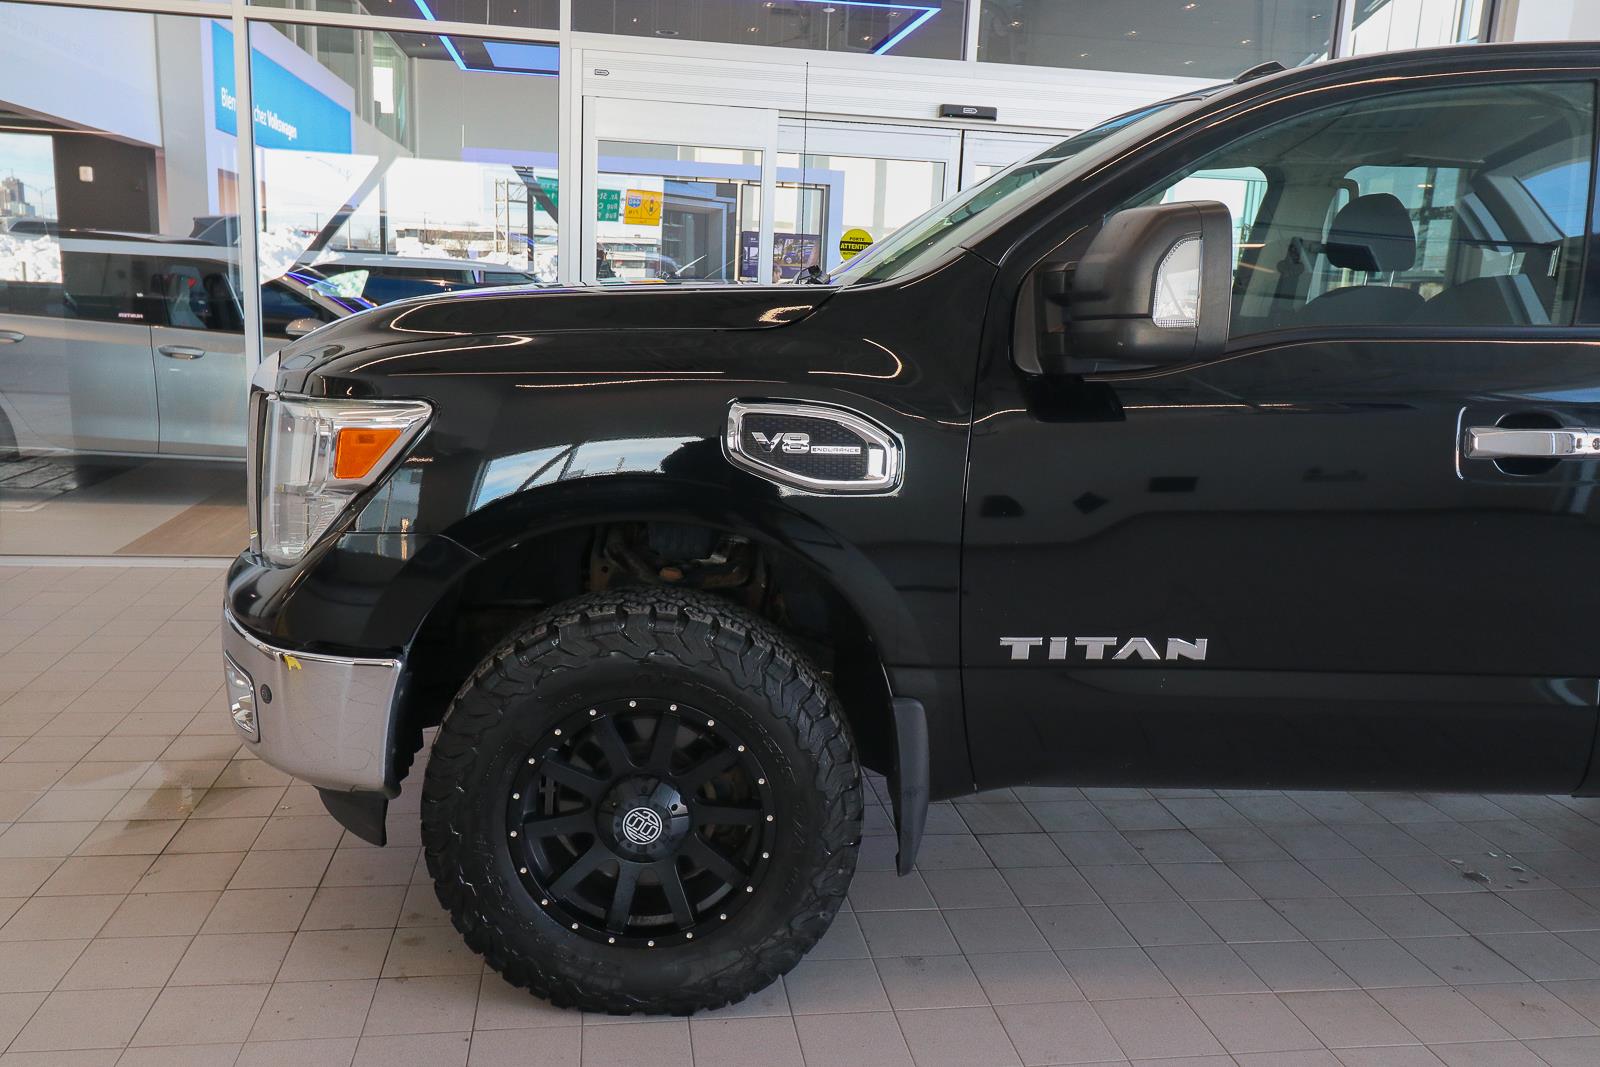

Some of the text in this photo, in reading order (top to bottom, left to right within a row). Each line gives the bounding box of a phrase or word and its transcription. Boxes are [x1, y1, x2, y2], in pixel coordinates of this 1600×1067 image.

[267, 109, 297, 141] Volkswagen
[751, 432, 810, 454] V8
[1000, 637, 1208, 660] TITAN
